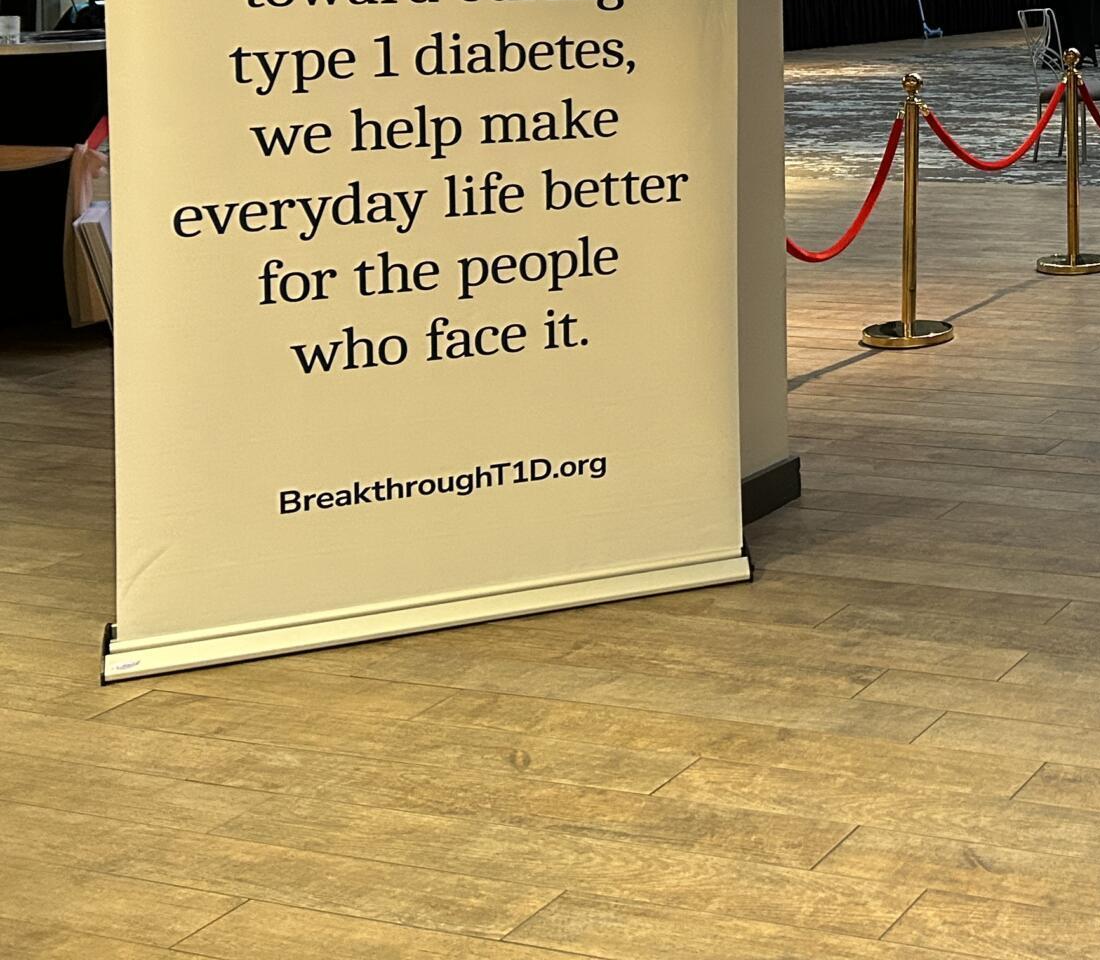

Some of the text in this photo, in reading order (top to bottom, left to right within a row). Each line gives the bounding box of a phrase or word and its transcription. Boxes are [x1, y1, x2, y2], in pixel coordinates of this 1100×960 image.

[228, 30, 637, 97] type 1 diabetes,
[250, 97, 619, 161] we help make
[171, 168, 690, 242] everyday life better
[258, 236, 619, 307] for the people
[290, 308, 590, 376] who face it.
[279, 455, 607, 516] BreakthroughT1D.org
